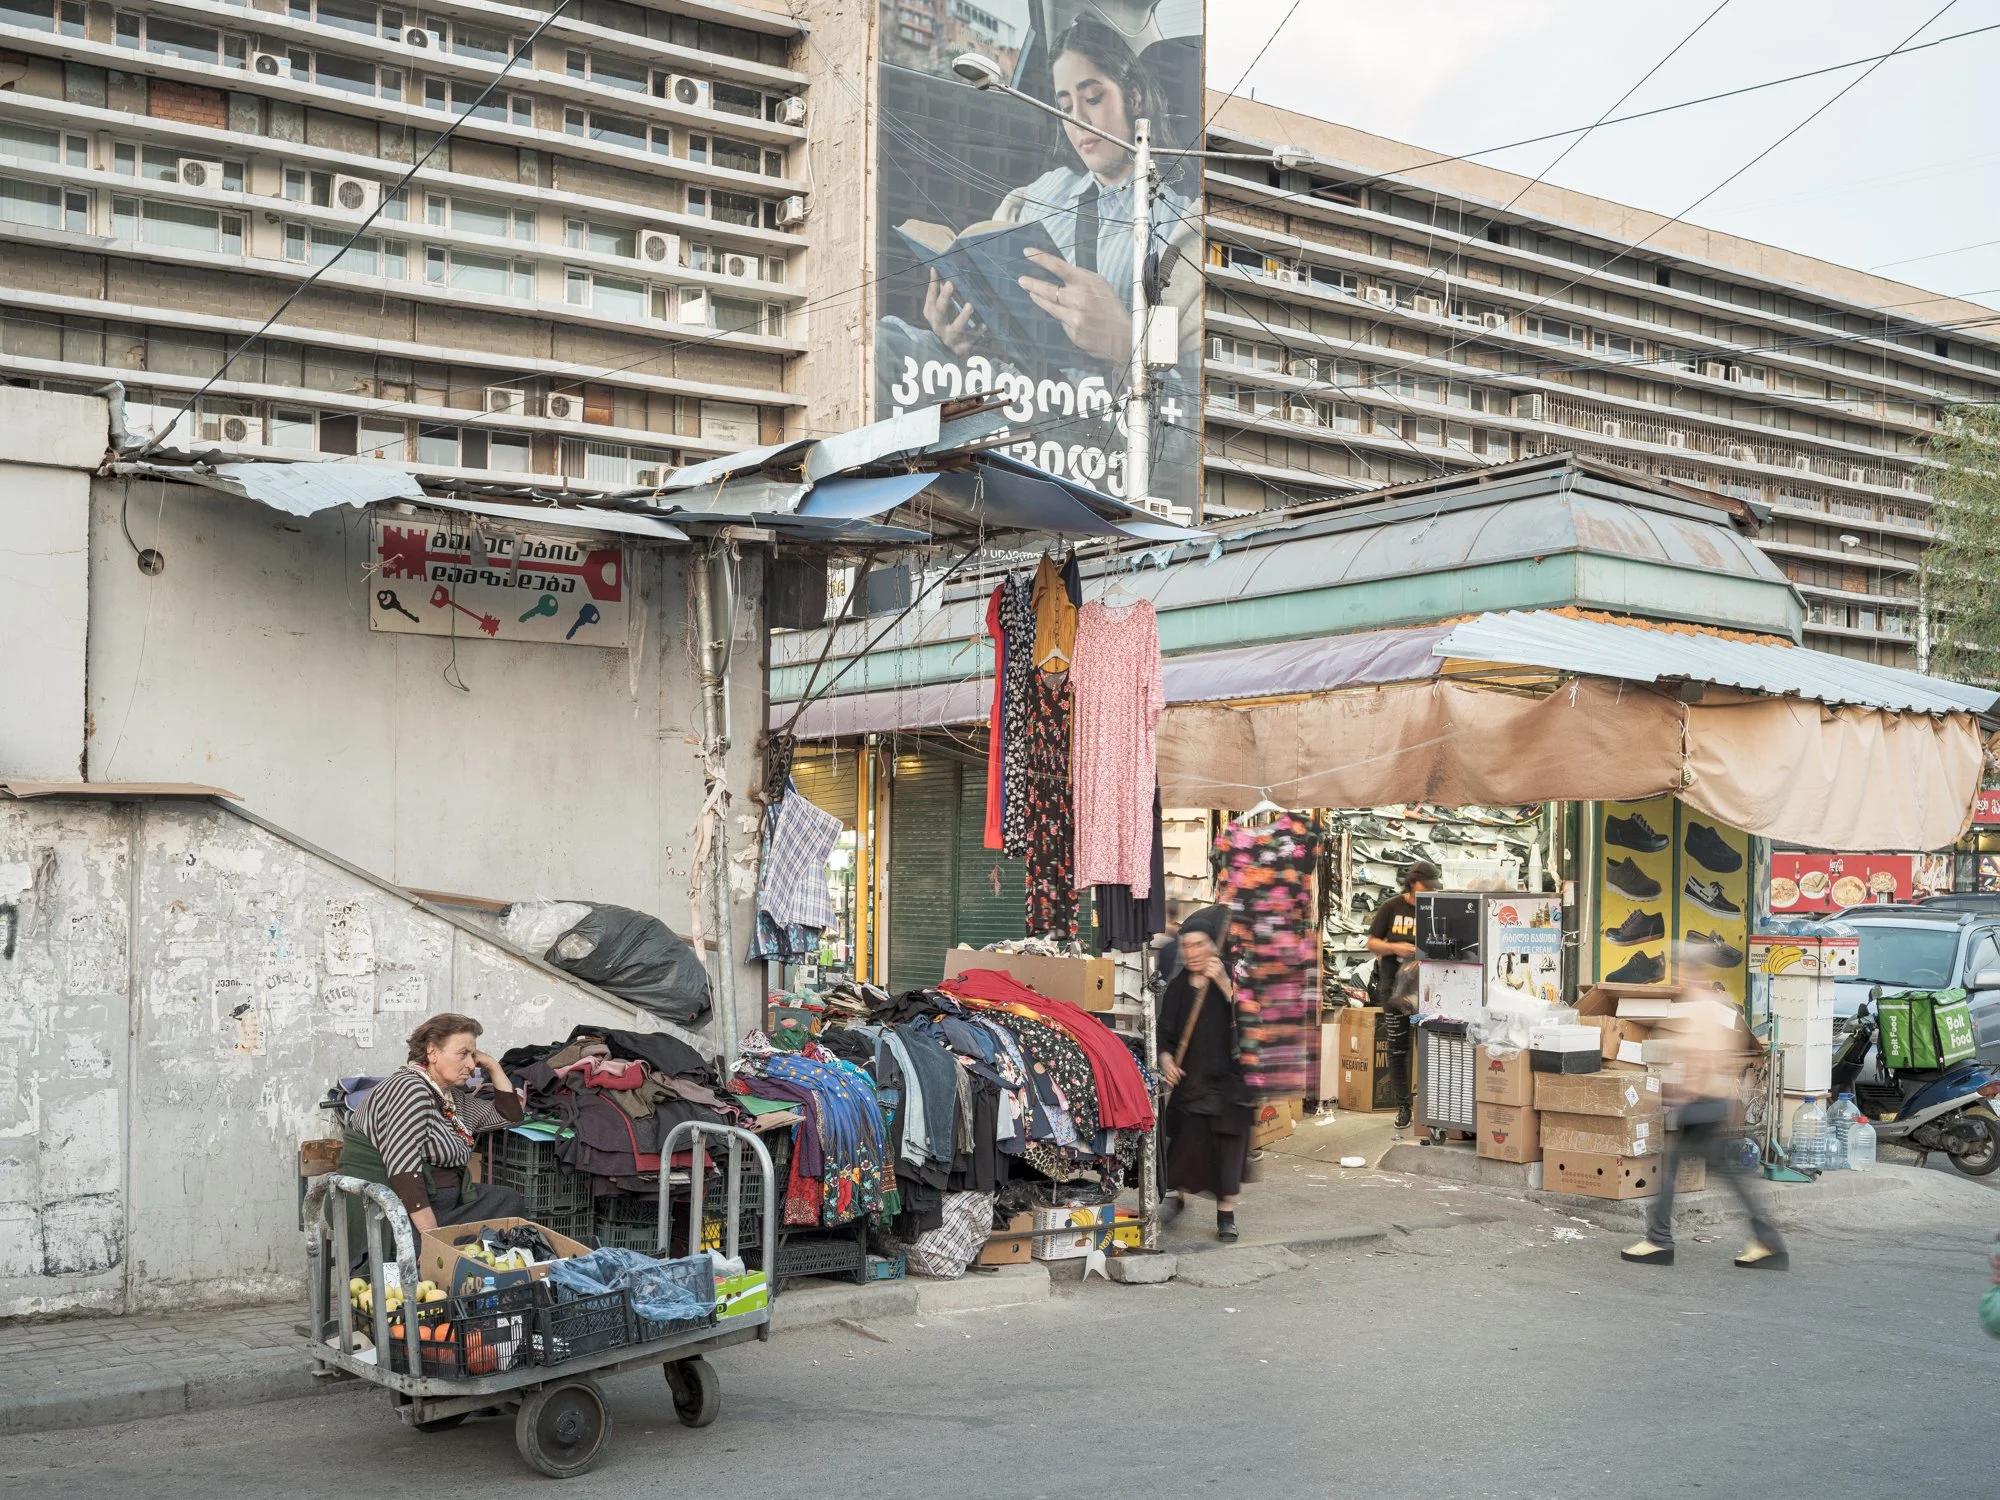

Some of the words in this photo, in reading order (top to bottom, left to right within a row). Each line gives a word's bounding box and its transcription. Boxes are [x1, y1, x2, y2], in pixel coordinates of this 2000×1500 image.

[1392, 915, 1416, 936] AP
[1889, 1016, 1897, 1037] Food
[1945, 1014, 1965, 1031] Bolt
[1890, 1037, 1899, 1056] Bolt
[1951, 1030, 1972, 1048] Food
[1341, 1058, 1369, 1072] MEGAVIEW
